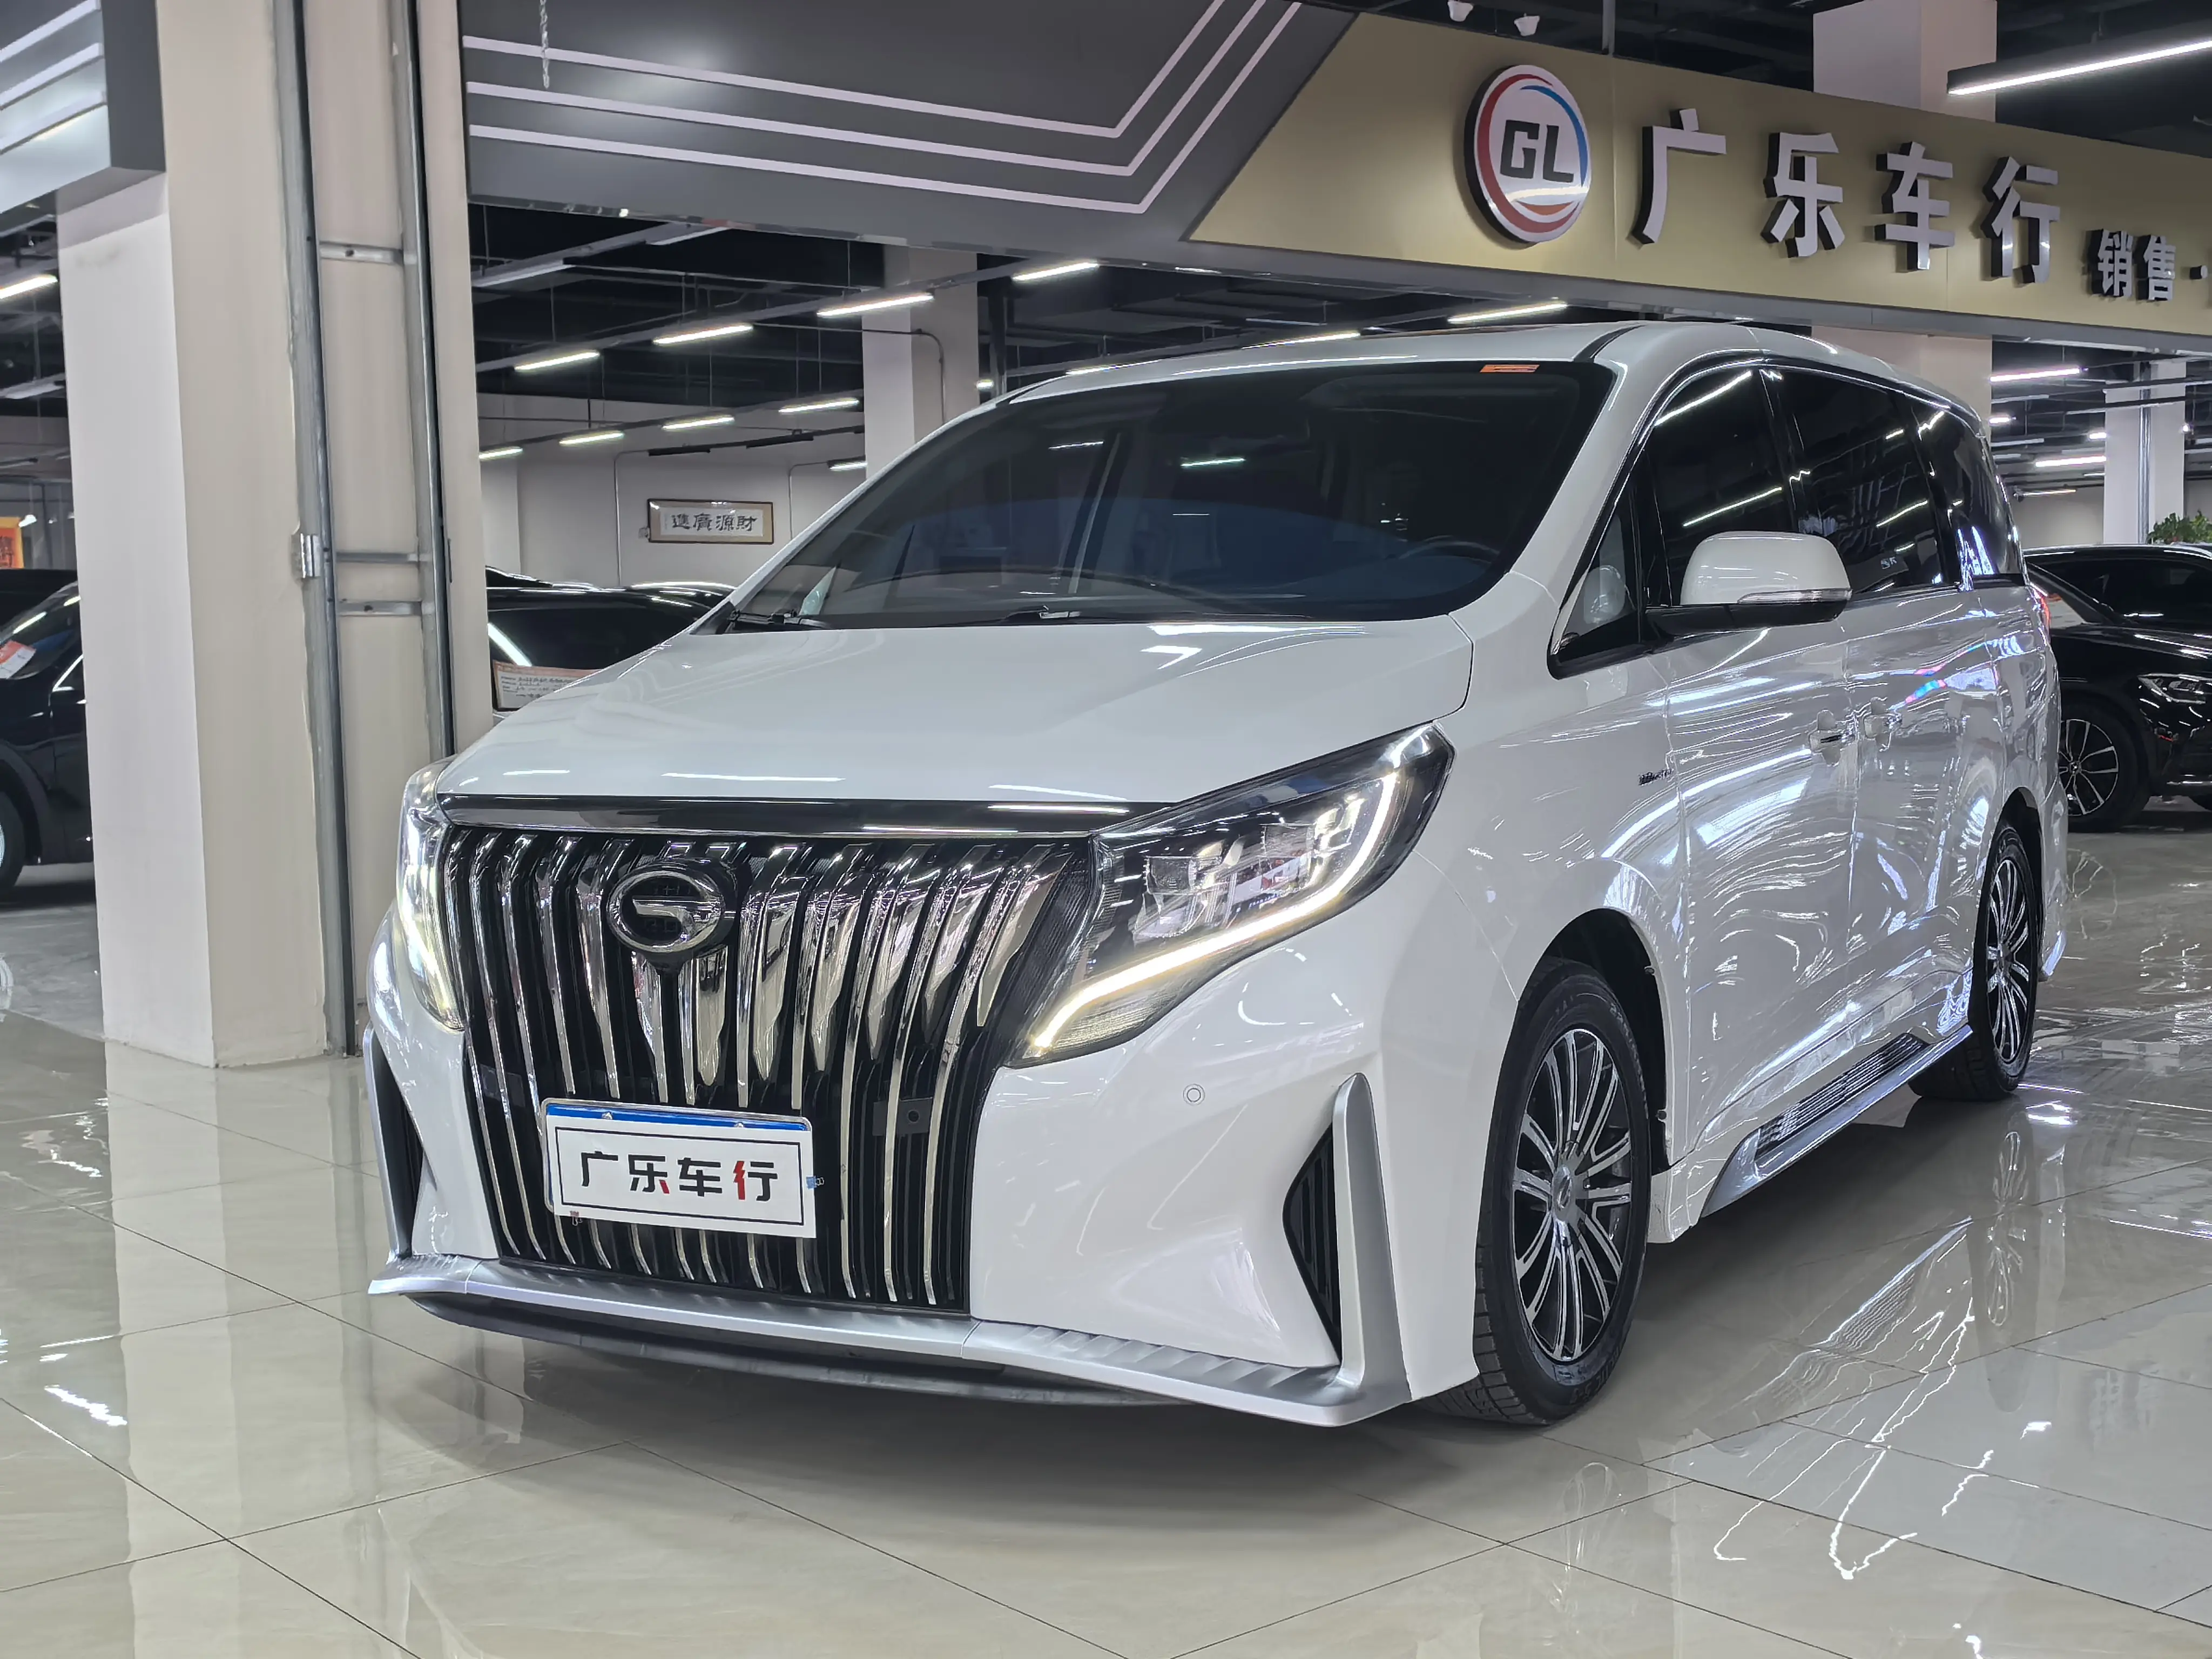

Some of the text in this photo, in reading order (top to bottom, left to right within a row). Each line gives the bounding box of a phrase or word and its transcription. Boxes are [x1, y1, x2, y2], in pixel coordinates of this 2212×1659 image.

[1500, 119, 1574, 183] GL
[1634, 108, 2061, 284] 广乐车行
[581, 1151, 778, 1202] 广乐车行
